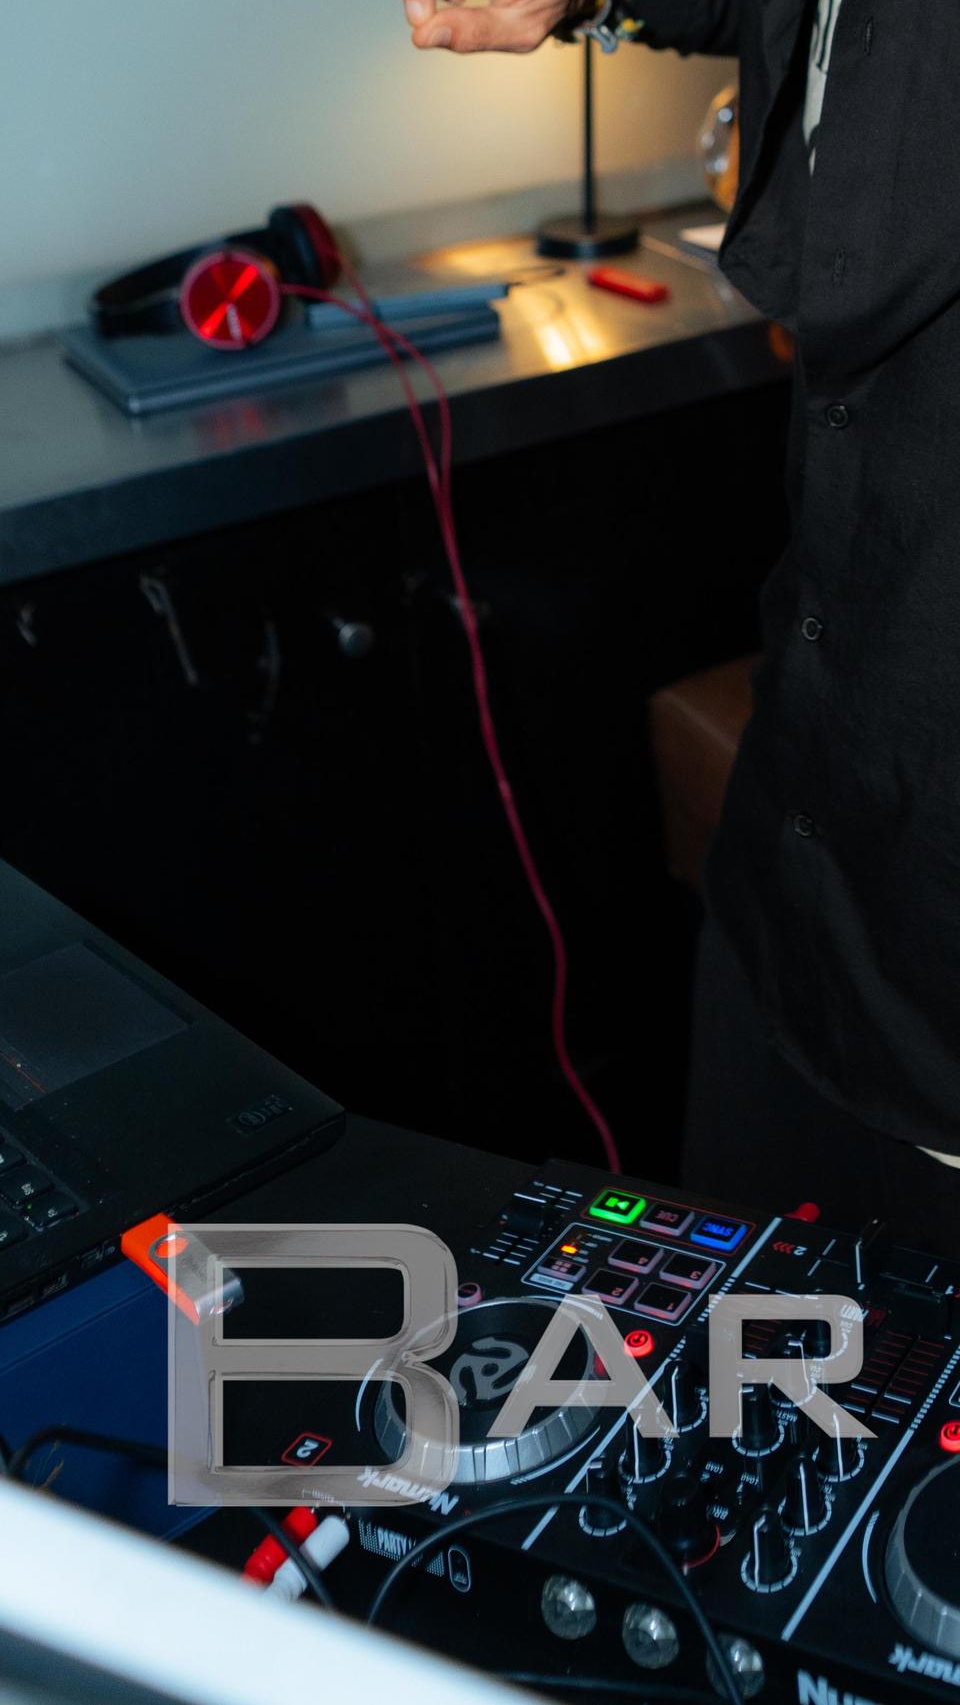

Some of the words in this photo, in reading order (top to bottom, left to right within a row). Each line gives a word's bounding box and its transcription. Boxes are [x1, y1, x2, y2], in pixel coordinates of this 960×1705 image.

[701, 1221, 735, 1238] SYNC
[792, 1245, 808, 1256] 2
[296, 1438, 320, 1458] 2
[357, 1465, 460, 1516] Numark
